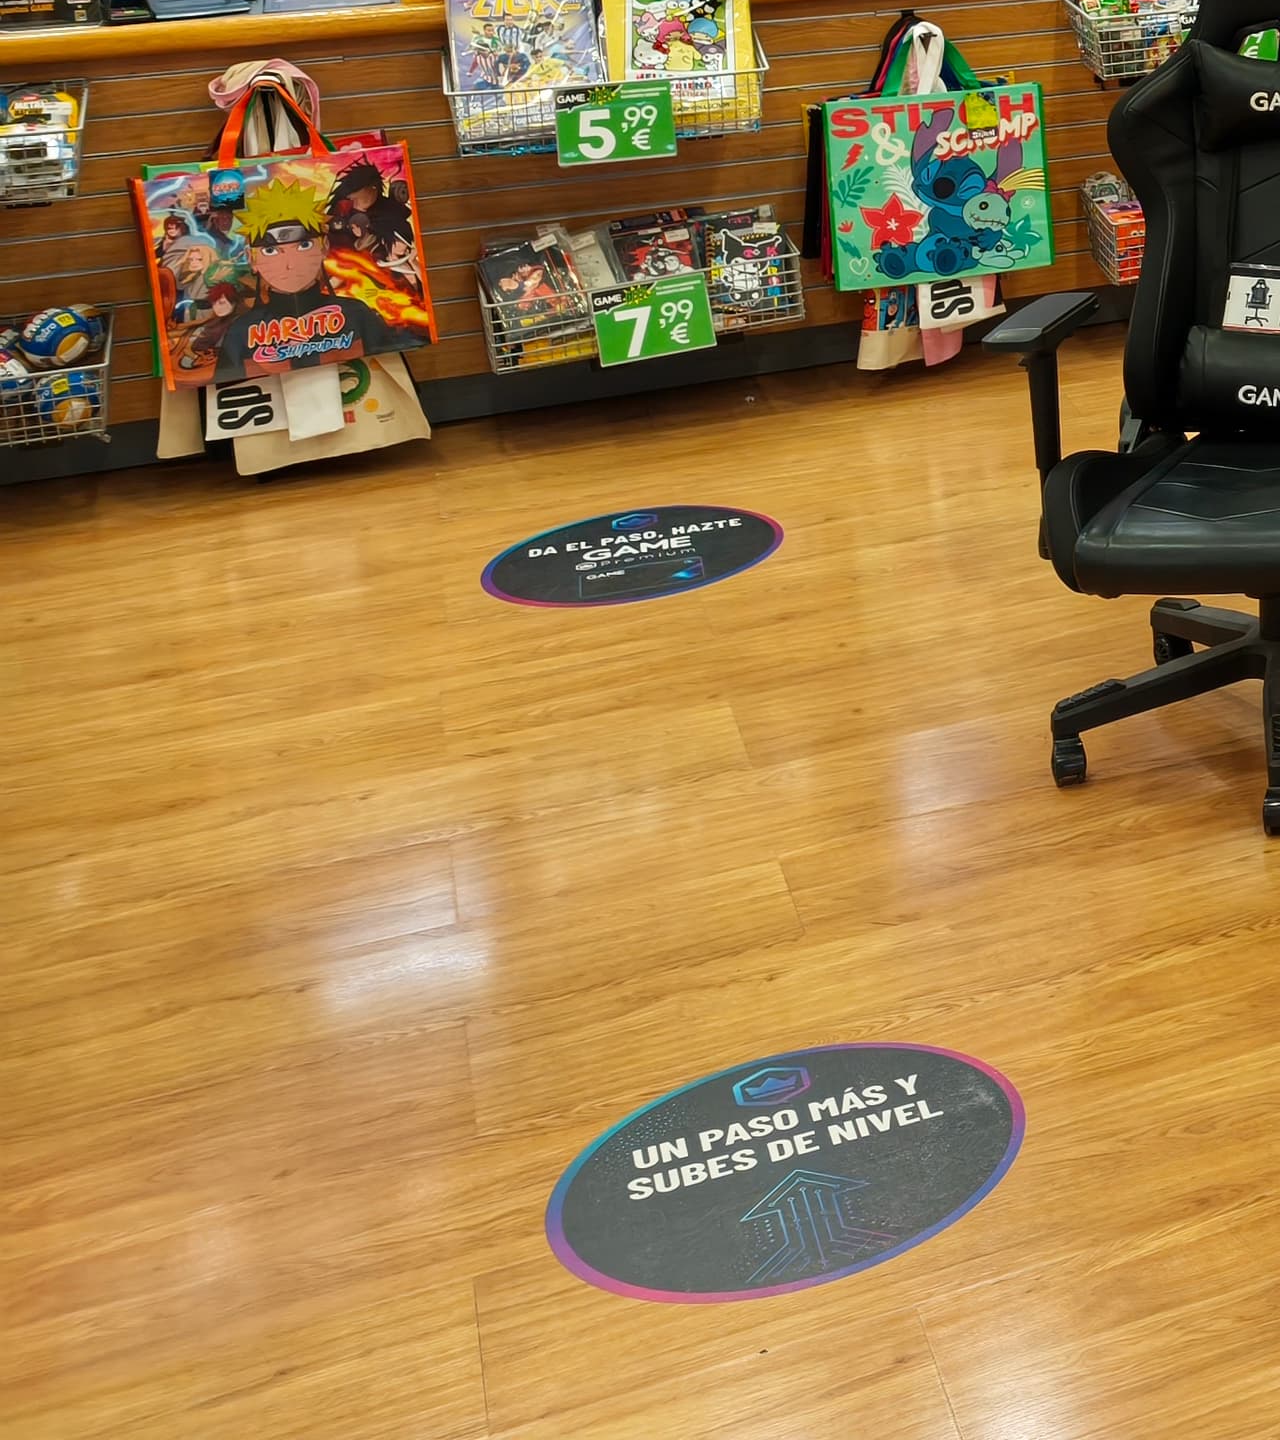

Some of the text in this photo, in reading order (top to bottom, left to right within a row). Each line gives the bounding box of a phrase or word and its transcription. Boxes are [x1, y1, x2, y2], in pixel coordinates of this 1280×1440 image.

[556, 93, 587, 104] GAME
[248, 306, 346, 348] NARUTO
[276, 332, 353, 362] SHIPPUDEN
[529, 518, 742, 558] DA EL PASO, HAZTE
[583, 536, 692, 561] GAME
[601, 548, 696, 568] Premium
[631, 1073, 920, 1171] UN PASO MÁS Y
[626, 1099, 944, 1202] SUBES DE NIVEL
